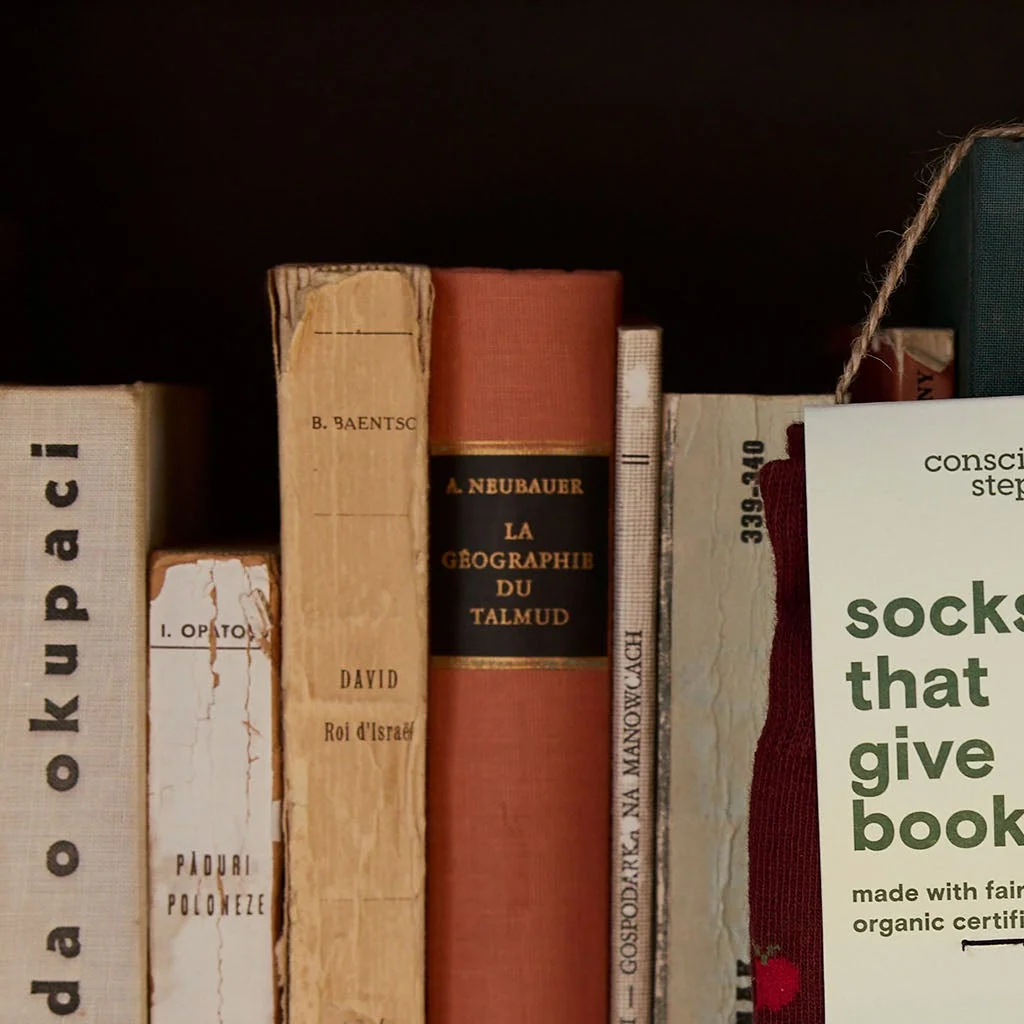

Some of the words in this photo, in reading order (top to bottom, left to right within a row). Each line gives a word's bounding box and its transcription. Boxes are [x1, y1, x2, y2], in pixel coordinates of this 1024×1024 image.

[311, 416, 328, 430] B.
[445, 476, 463, 495] A.
[467, 477, 585, 496] NEUBAUER
[503, 521, 535, 541] LA
[495, 578, 533, 598] DU
[28, 443, 90, 793] okupaci
[469, 607, 570, 626] TALMUD
[161, 623, 172, 638] I.
[340, 668, 399, 689] DAVID
[844, 655, 991, 712] that
[622, 630, 643, 777] MANOWCACH
[324, 721, 350, 742] Roi
[848, 725, 996, 798] give
[621, 787, 641, 818] NA
[46, 840, 81, 878] o
[852, 884, 919, 903] made
[927, 881, 978, 902] with
[167, 893, 264, 916] POLONEZE
[852, 911, 946, 938] organic
